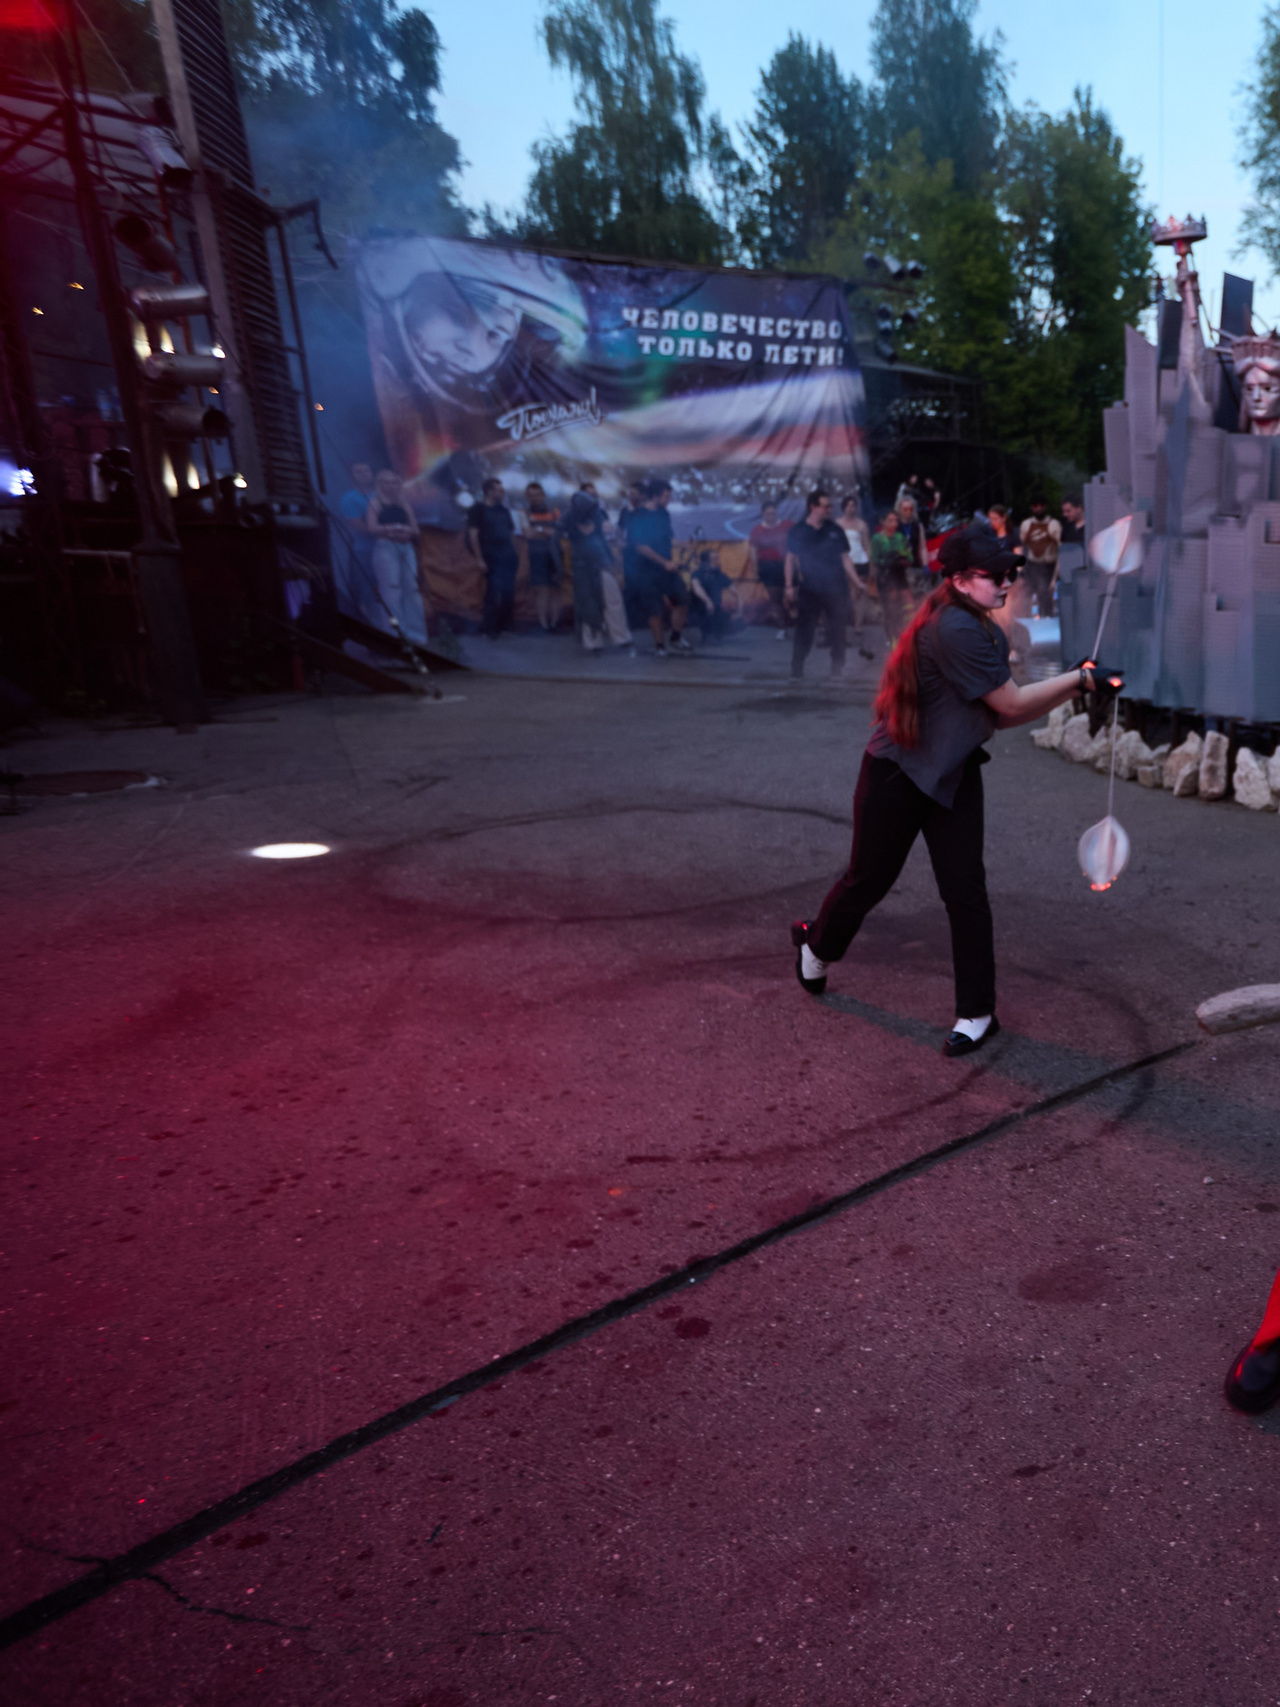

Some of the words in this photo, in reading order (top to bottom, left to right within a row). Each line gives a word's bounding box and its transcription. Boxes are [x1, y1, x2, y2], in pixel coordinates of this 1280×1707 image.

[621, 306, 849, 342] ЧЕЛОВЕЧЕСТВО,
[637, 335, 753, 361] ТОЛЬКО
[763, 343, 844, 366] ЛЕТИ!
